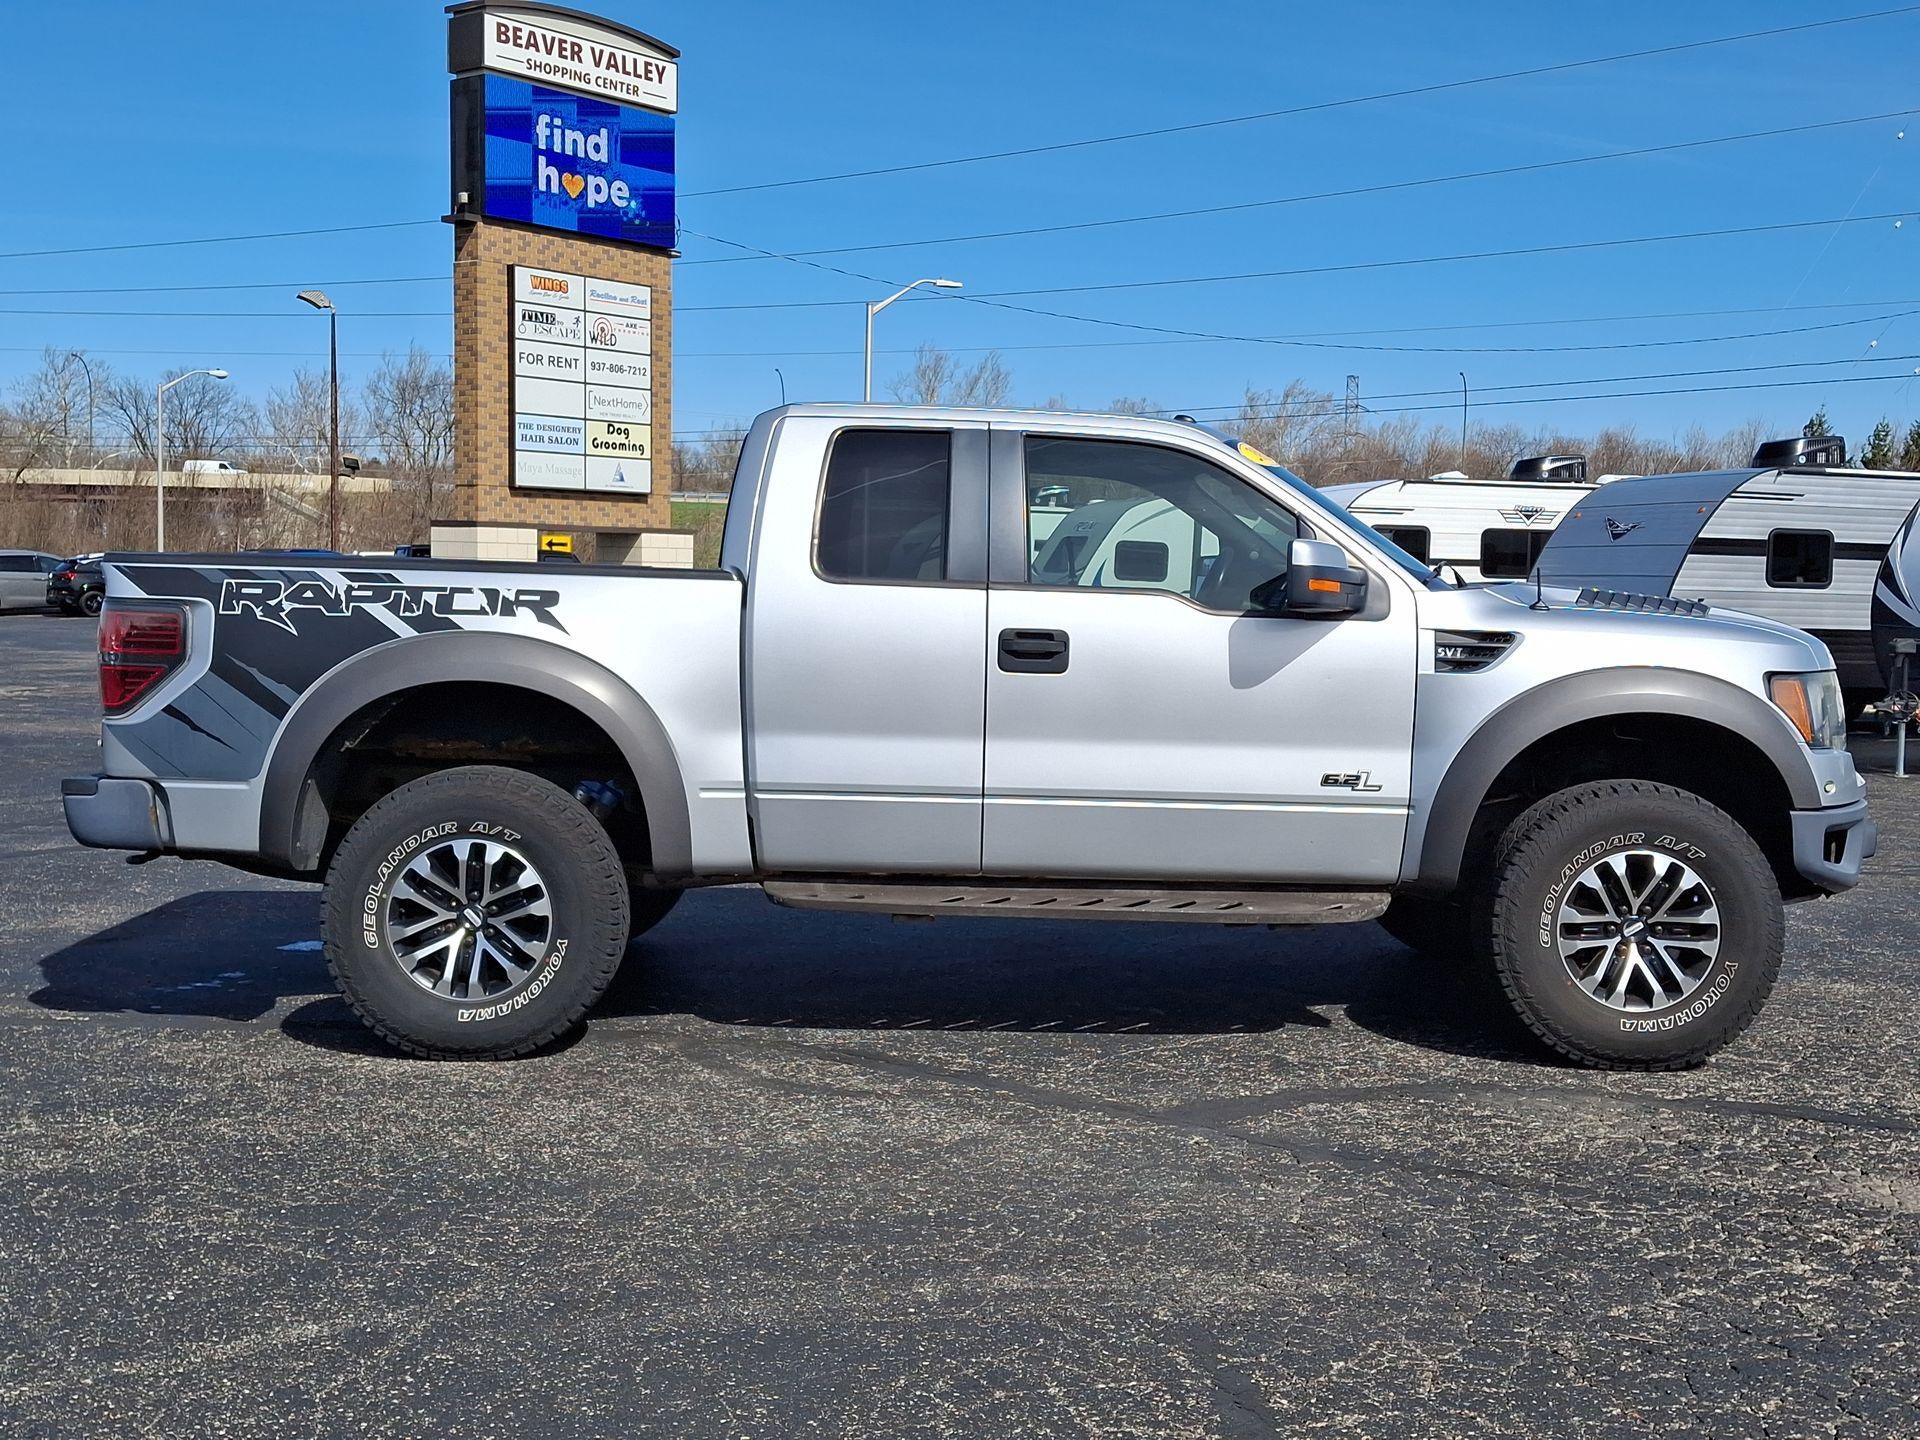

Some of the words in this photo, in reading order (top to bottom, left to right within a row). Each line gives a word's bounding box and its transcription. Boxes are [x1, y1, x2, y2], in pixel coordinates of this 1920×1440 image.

[496, 21, 583, 64] BEAVER
[590, 46, 667, 84] VALLEY
[526, 58, 591, 85] SHOPPING
[595, 76, 640, 97] CENTER
[536, 114, 609, 163] find
[530, 275, 568, 294] WINGS
[522, 309, 556, 325] TIME
[534, 324, 581, 340] ESCAPE
[589, 330, 617, 346] WILD
[519, 352, 544, 366] FOR
[548, 355, 580, 370] RENT
[590, 361, 647, 377] 937-806-7212
[594, 395, 643, 409] NextHome
[518, 422, 534, 430] THE
[536, 424, 582, 434] DESIGNERY
[607, 423, 630, 440] Dog
[521, 434, 545, 444] HAIR
[548, 435, 579, 446] SALON
[592, 437, 645, 456] Grooming
[518, 461, 542, 474] Maya
[545, 463, 582, 480] Massage
[219, 579, 571, 636] RAPTOR
[1437, 647, 1465, 658] SVT
[363, 821, 458, 949] GEOLANDAR
[469, 821, 521, 842] A/T
[1540, 832, 1645, 948] GEOLANDAR
[1655, 835, 1706, 860] A/T
[458, 939, 568, 1022] YOKOHAMA
[1620, 961, 1738, 1032] YOKOHAMA
